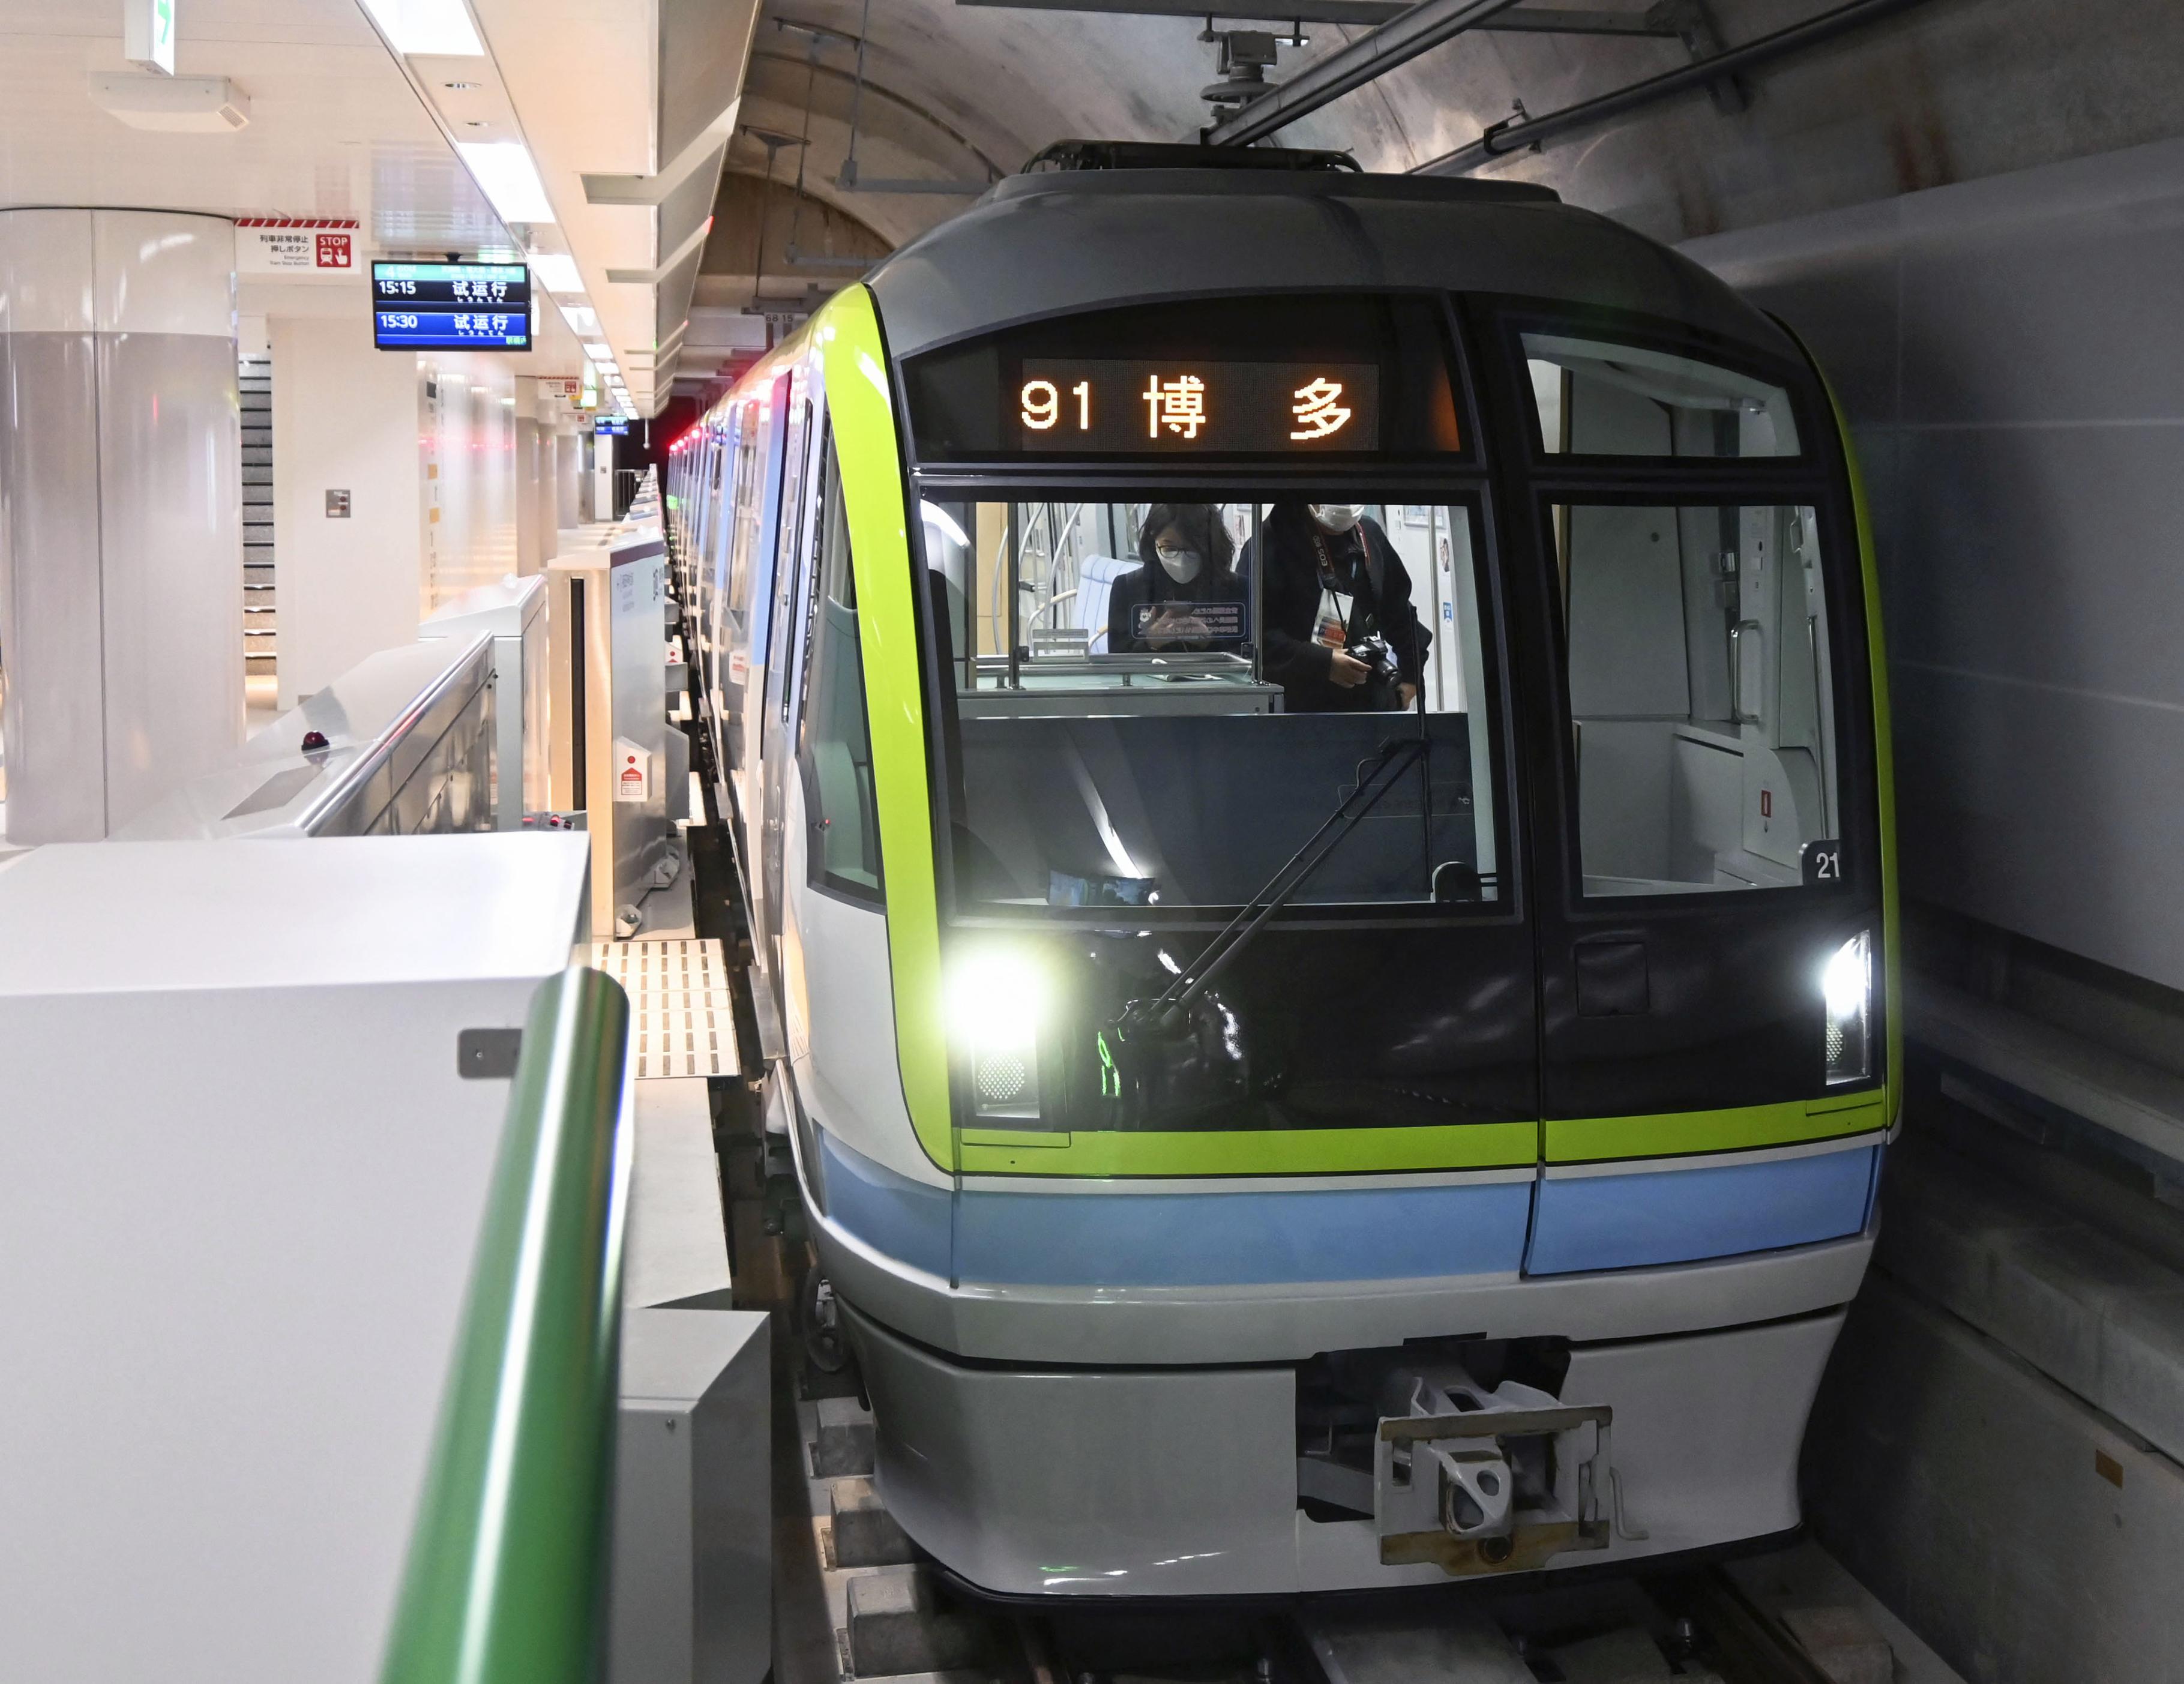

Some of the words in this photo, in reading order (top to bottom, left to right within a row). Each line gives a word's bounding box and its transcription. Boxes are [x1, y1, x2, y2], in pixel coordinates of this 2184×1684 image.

[260, 235, 309, 243] 列車非常停止
[319, 236, 348, 246] STOP
[379, 281, 417, 295] 15:15
[381, 314, 418, 329] 15:30
[1021, 380, 1088, 430] 91
[1142, 374, 1351, 440] 博多
[1317, 548, 1328, 567] EOS
[1816, 852, 1840, 879] 21
